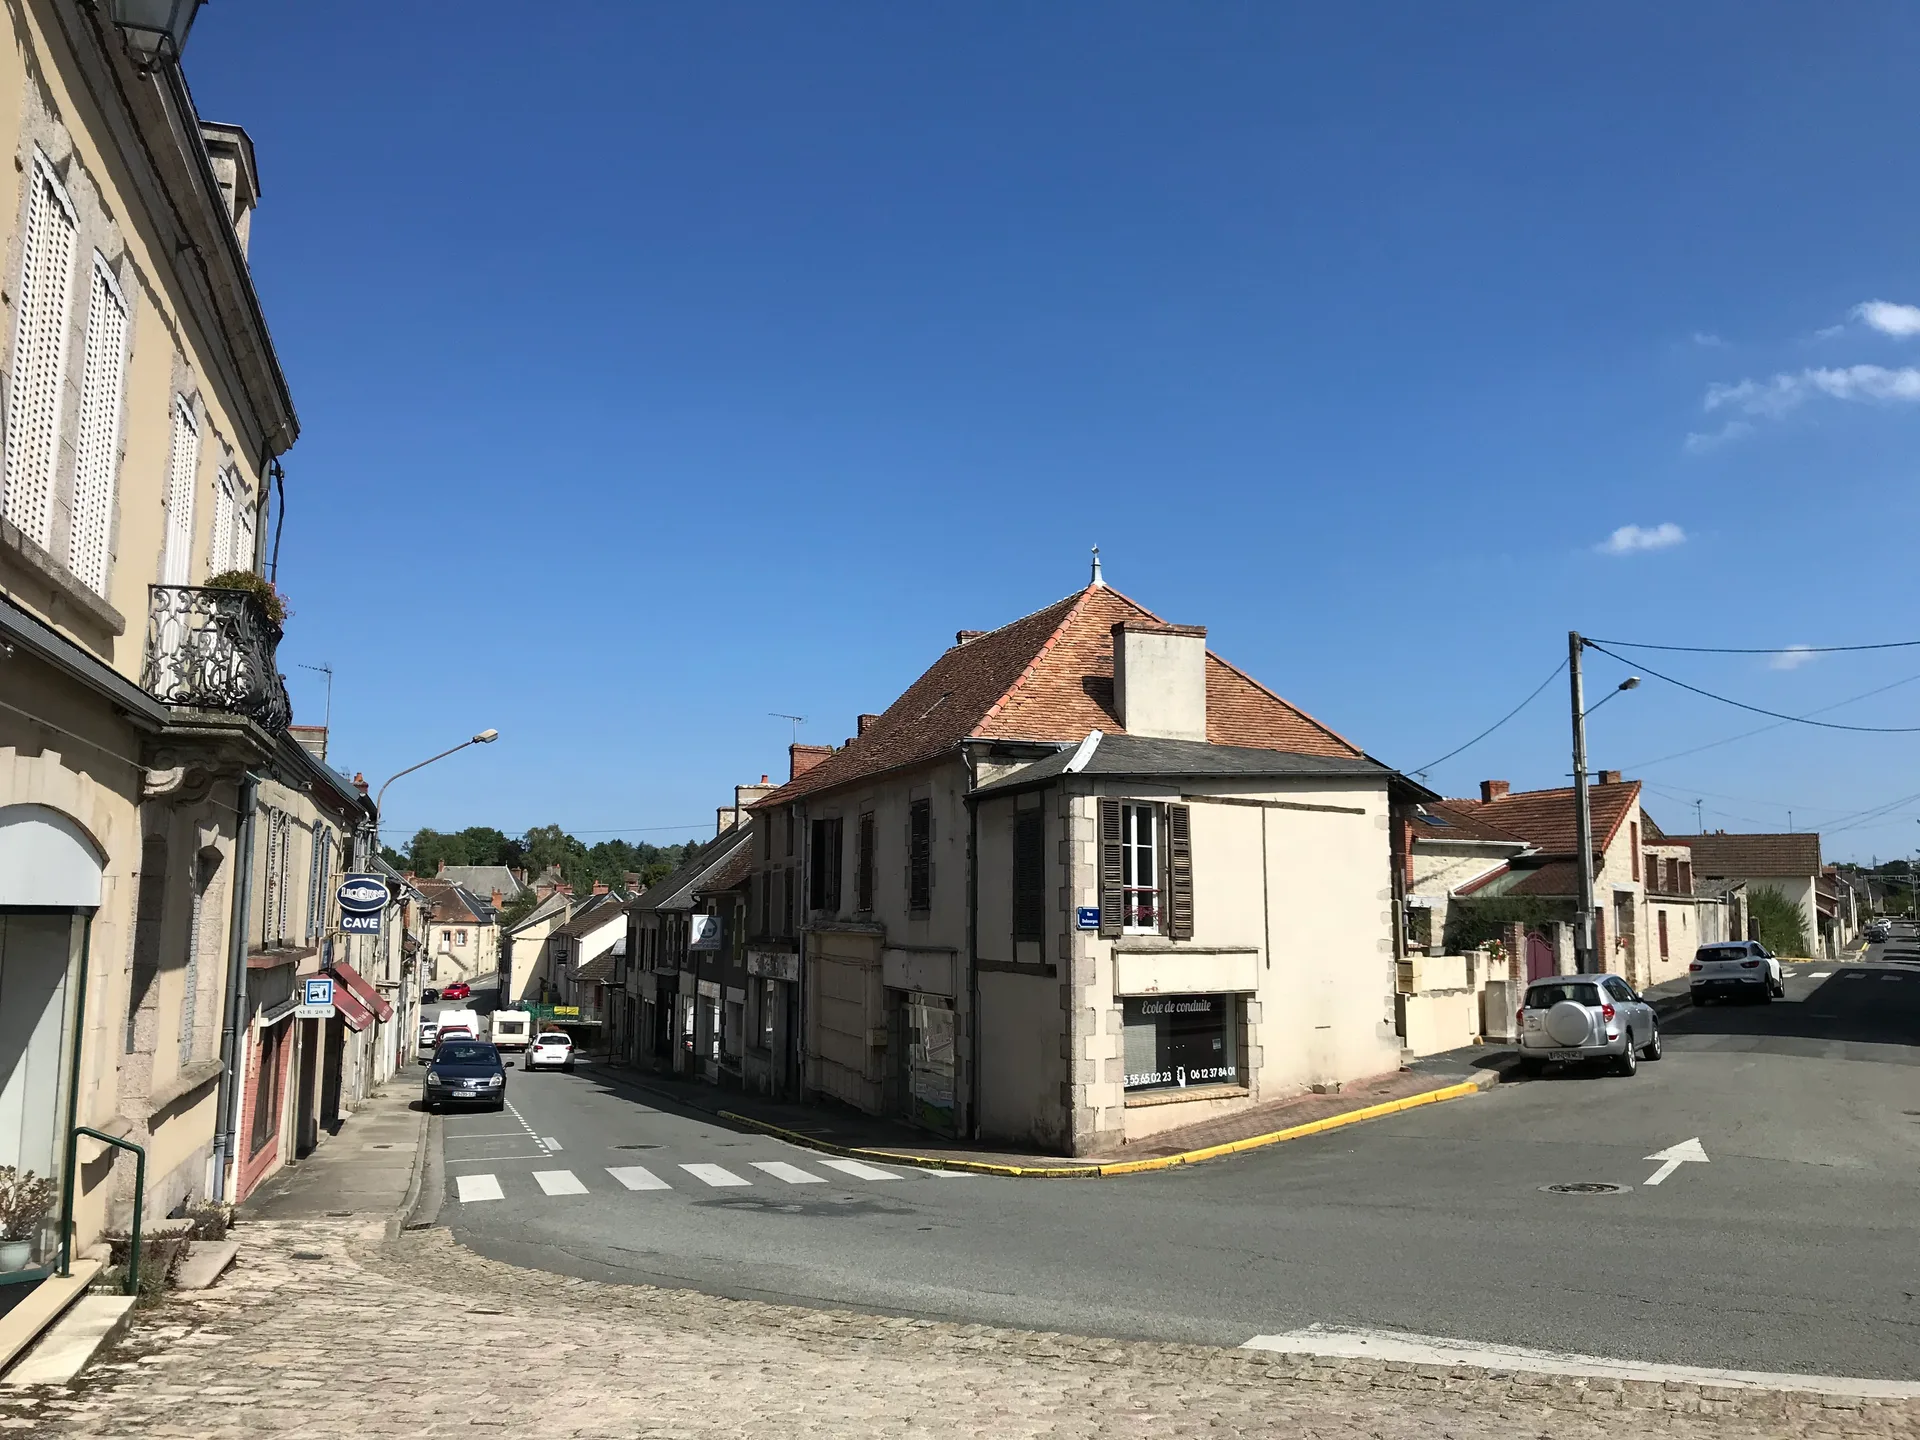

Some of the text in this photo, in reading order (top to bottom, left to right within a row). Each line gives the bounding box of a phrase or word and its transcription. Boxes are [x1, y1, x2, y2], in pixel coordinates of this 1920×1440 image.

[342, 917, 379, 929] CAVE
[1142, 999, 1212, 1015] Ecole de conduite
